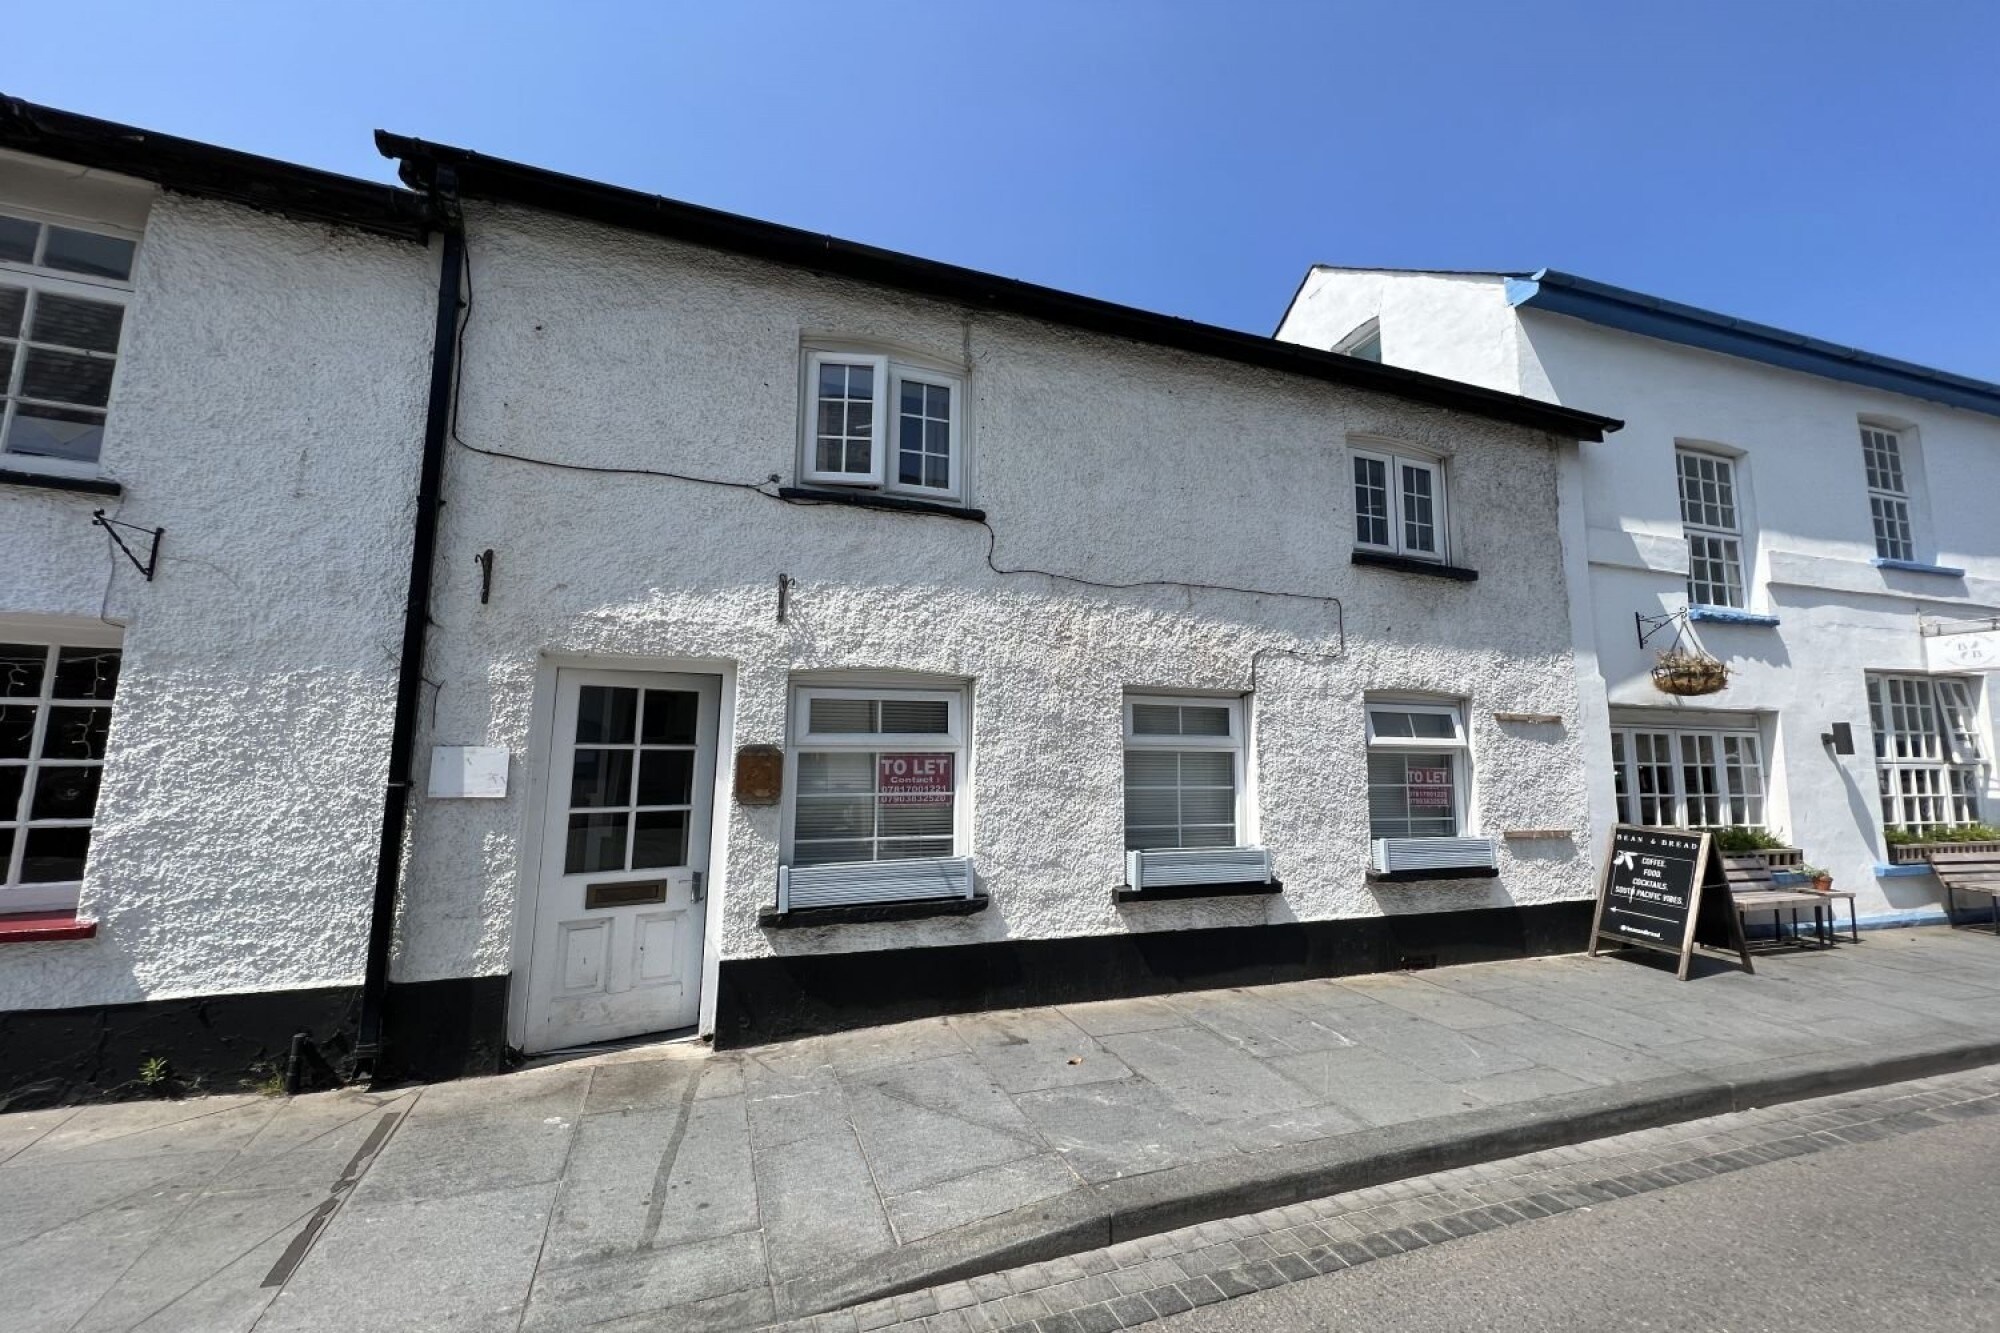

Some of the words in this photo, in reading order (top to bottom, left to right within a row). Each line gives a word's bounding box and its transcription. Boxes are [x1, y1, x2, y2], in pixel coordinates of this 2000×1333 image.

[881, 759, 907, 775] TO
[913, 759, 947, 775] LET
[891, 776, 933, 784] Contact
[1409, 771, 1423, 783] TO
[1427, 771, 1447, 783] LET
[1617, 834, 1643, 842] BEAN
[1661, 839, 1698, 850] BREAD
